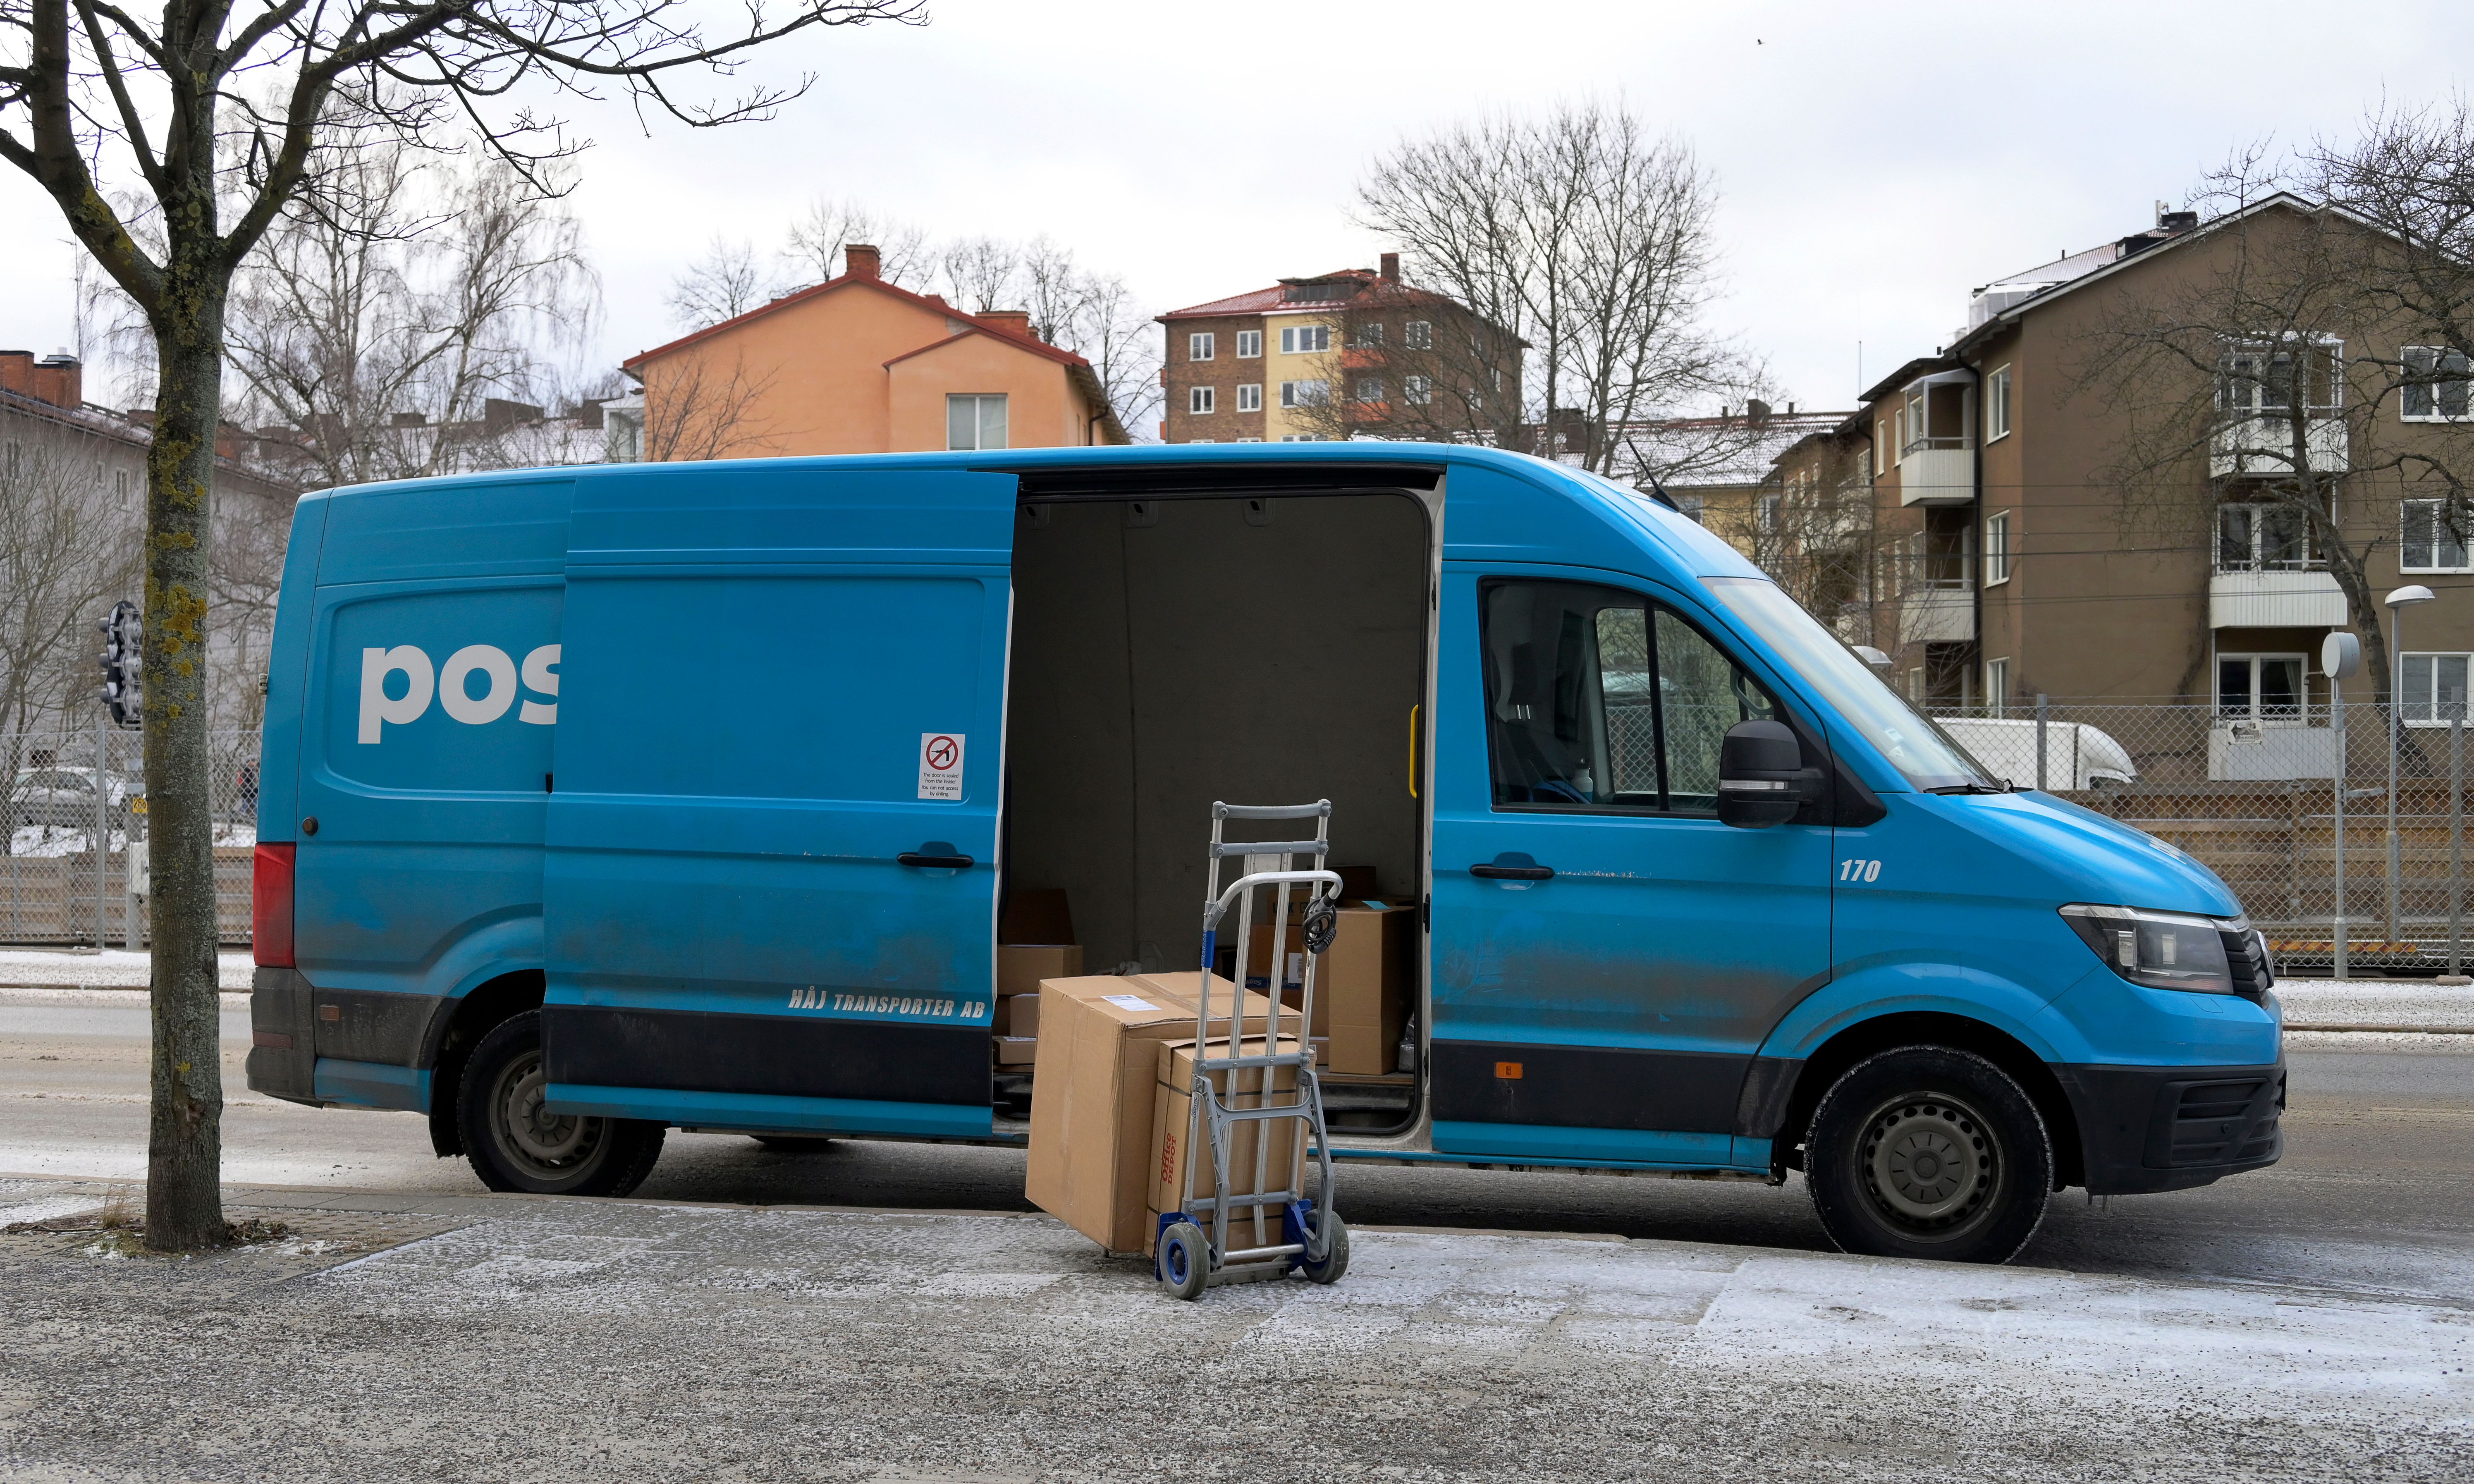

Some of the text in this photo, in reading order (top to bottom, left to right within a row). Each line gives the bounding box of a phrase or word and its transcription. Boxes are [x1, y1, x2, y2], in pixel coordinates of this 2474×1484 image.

[358, 644, 561, 743] pos
[1841, 859, 1881, 882] 170
[788, 985, 985, 1018] HÅJ TRANSPORTER AB
[1162, 1133, 1172, 1182] Office
[1168, 1135, 1176, 1186] DEPOT
